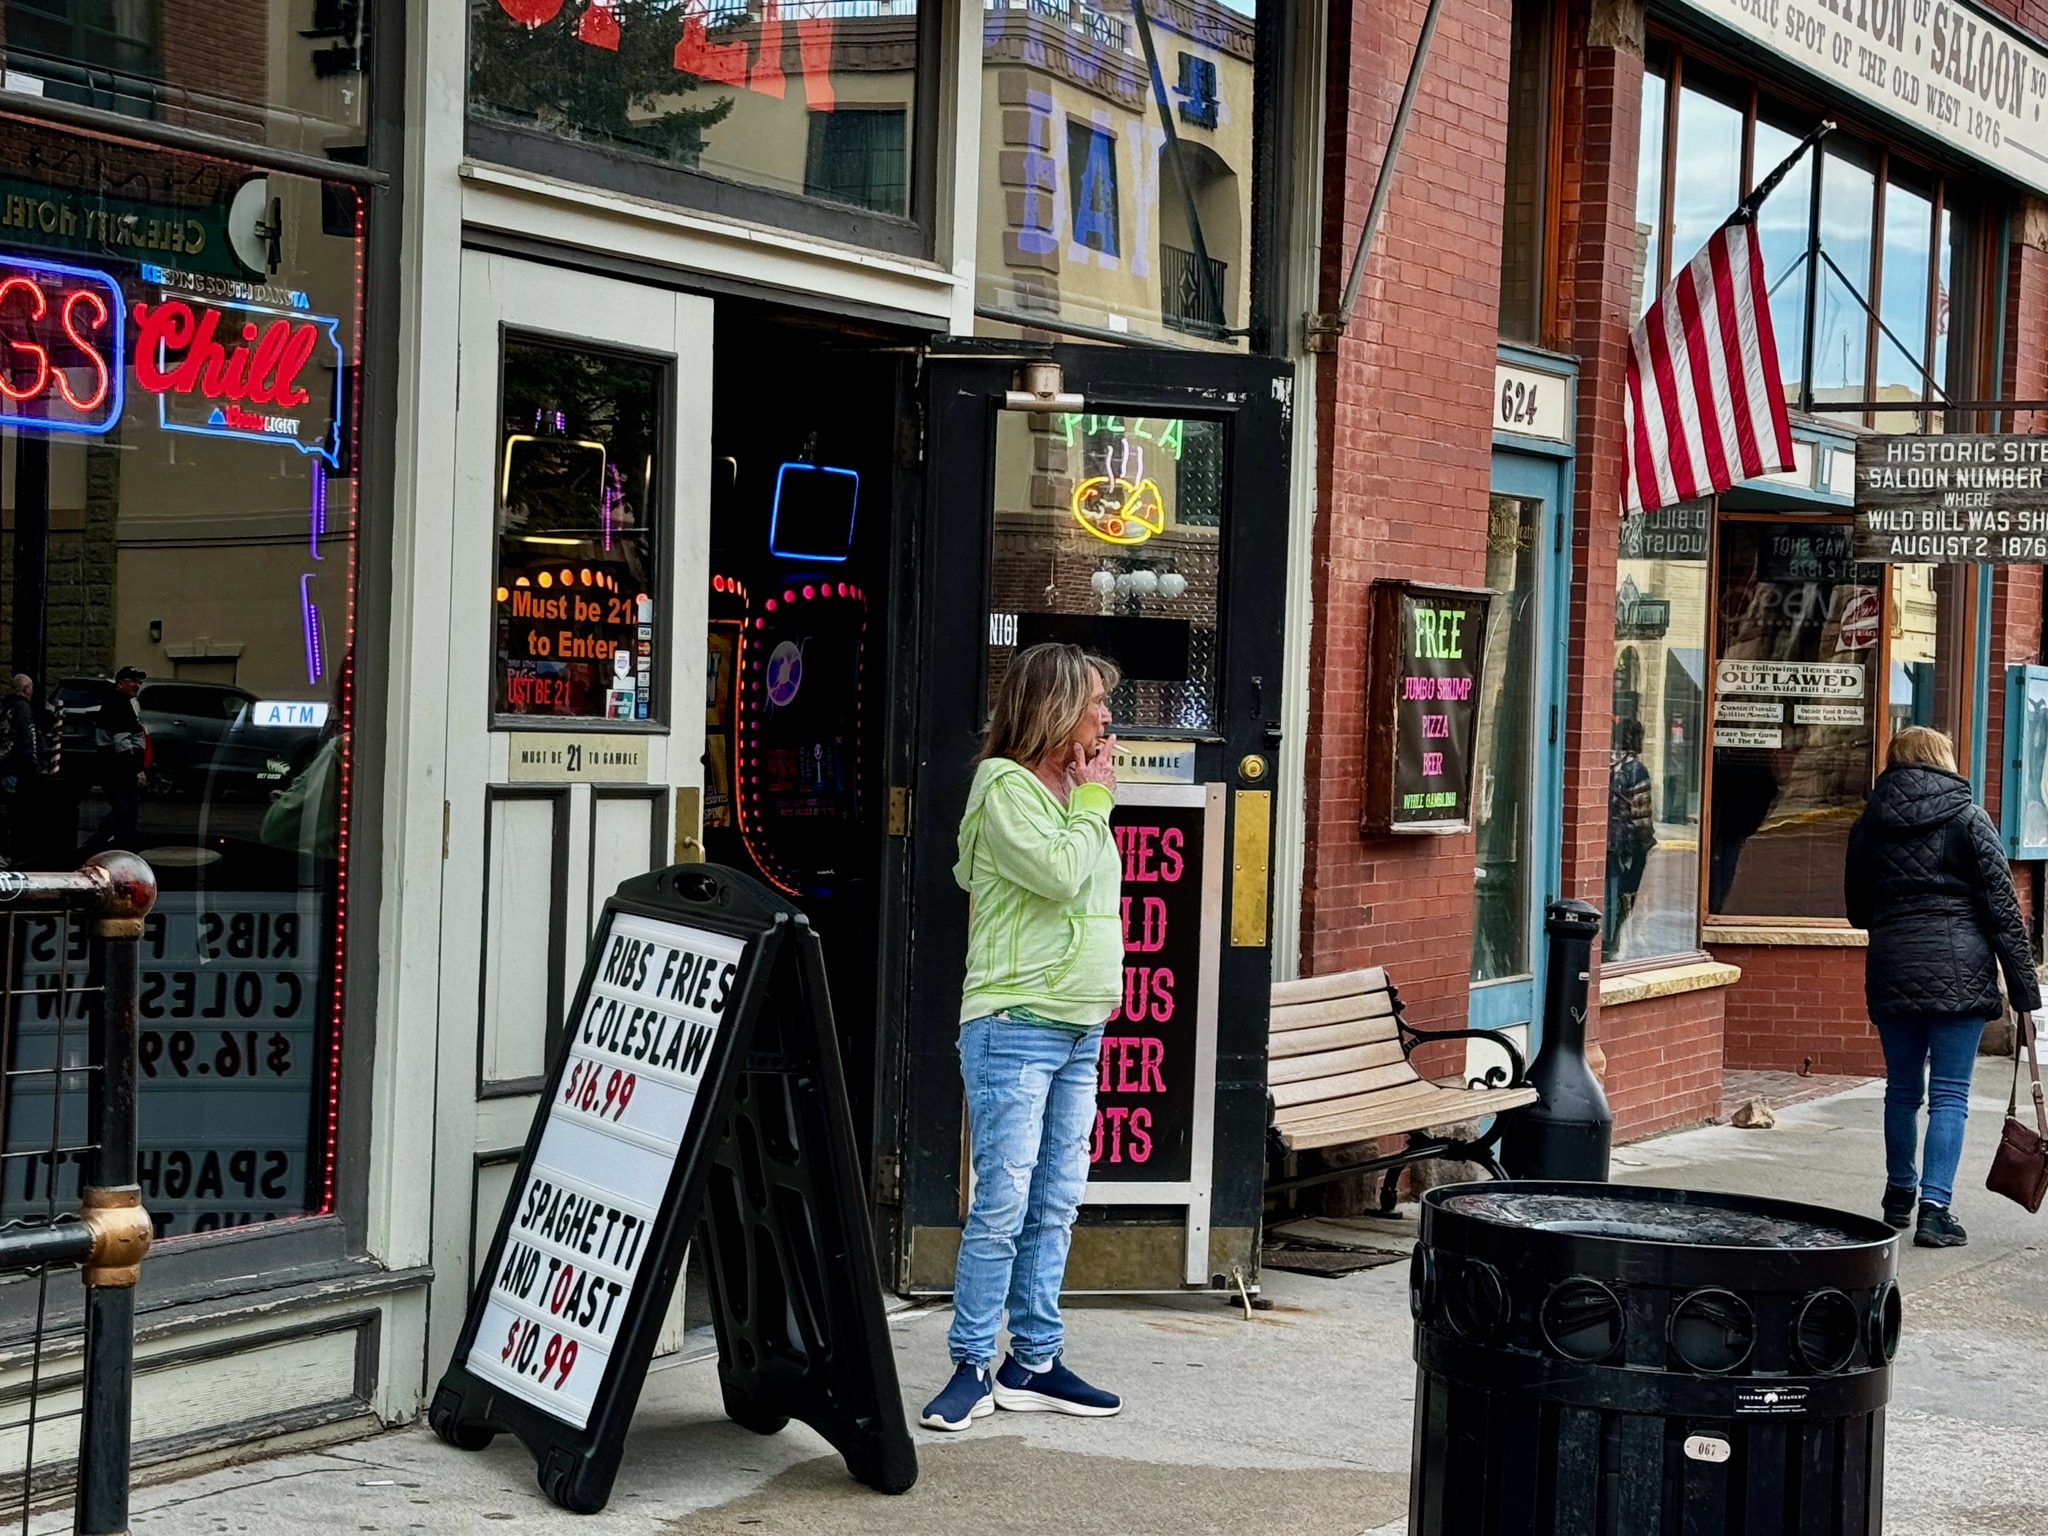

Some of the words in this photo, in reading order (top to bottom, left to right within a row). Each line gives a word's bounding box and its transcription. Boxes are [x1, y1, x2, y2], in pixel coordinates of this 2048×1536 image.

[1914, 0, 1930, 28] OF
[1931, 1, 2028, 119] SALOON
[1729, 0, 1779, 29] RIC
[1785, 4, 1826, 55] SPOT
[1832, 32, 1853, 69] OF
[1858, 46, 1887, 89] THE
[1893, 65, 1920, 107] OLD
[1926, 84, 1961, 127] WEST
[1967, 106, 2000, 149] 1876
[141, 263, 204, 290] KEEPING
[207, 276, 253, 299] SOUTH
[255, 285, 311, 309] DAKOTA
[133, 301, 318, 408] Chill
[1501, 379, 1537, 425] 624
[264, 416, 300, 435] LIGHT
[1887, 442, 1996, 463] HISTORIC
[1869, 467, 1949, 489] SALOON
[1956, 467, 2042, 489] NUMBER
[1944, 492, 1992, 507] WHERE
[1868, 510, 1914, 531] WILD
[1922, 510, 1964, 531] BILL
[1968, 511, 2010, 531] WAS
[2018, 511, 2048, 531] SH
[1890, 536, 1971, 556] AUGUST
[2002, 537, 2047, 557] 1876
[512, 590, 568, 619] Must
[575, 594, 601, 622] be
[528, 629, 550, 656] to
[558, 631, 618, 660] Enter
[1413, 608, 1467, 659] FREE
[1721, 671, 1857, 687] OUTLAWED
[1730, 664, 1748, 672] The
[1751, 664, 1800, 674] following
[535, 679, 552, 704] BE
[554, 680, 571, 705] 21
[1402, 677, 1435, 700] JUMBO
[1436, 677, 1472, 700] SHRIMP
[1750, 683, 1769, 691] the
[1773, 684, 1797, 693] Wild
[1800, 684, 1819, 693] Bill
[268, 705, 314, 724] ATM
[1422, 715, 1449, 738] PIZZA
[1716, 730, 1738, 738] Leave
[521, 750, 546, 764] MUST
[551, 751, 562, 764] BE
[566, 744, 582, 772] 21
[589, 752, 599, 765] TO
[603, 752, 638, 765] GAMBLE
[1112, 755, 1124, 766] TO
[1131, 755, 1180, 769] GAMBLE
[1422, 752, 1443, 776] BEER
[603, 935, 655, 992] RIBS
[656, 949, 737, 1014] FRIES
[1110, 967, 1175, 1023] US
[583, 996, 713, 1076] COLESLAW
[564, 1058, 637, 1123] $16.99
[521, 1179, 645, 1271] SPAGHETTI
[499, 1241, 541, 1300] AND
[539, 1257, 623, 1335] TOAST
[501, 1316, 579, 1391] $10.99
[1698, 1441, 1717, 1457] 067
